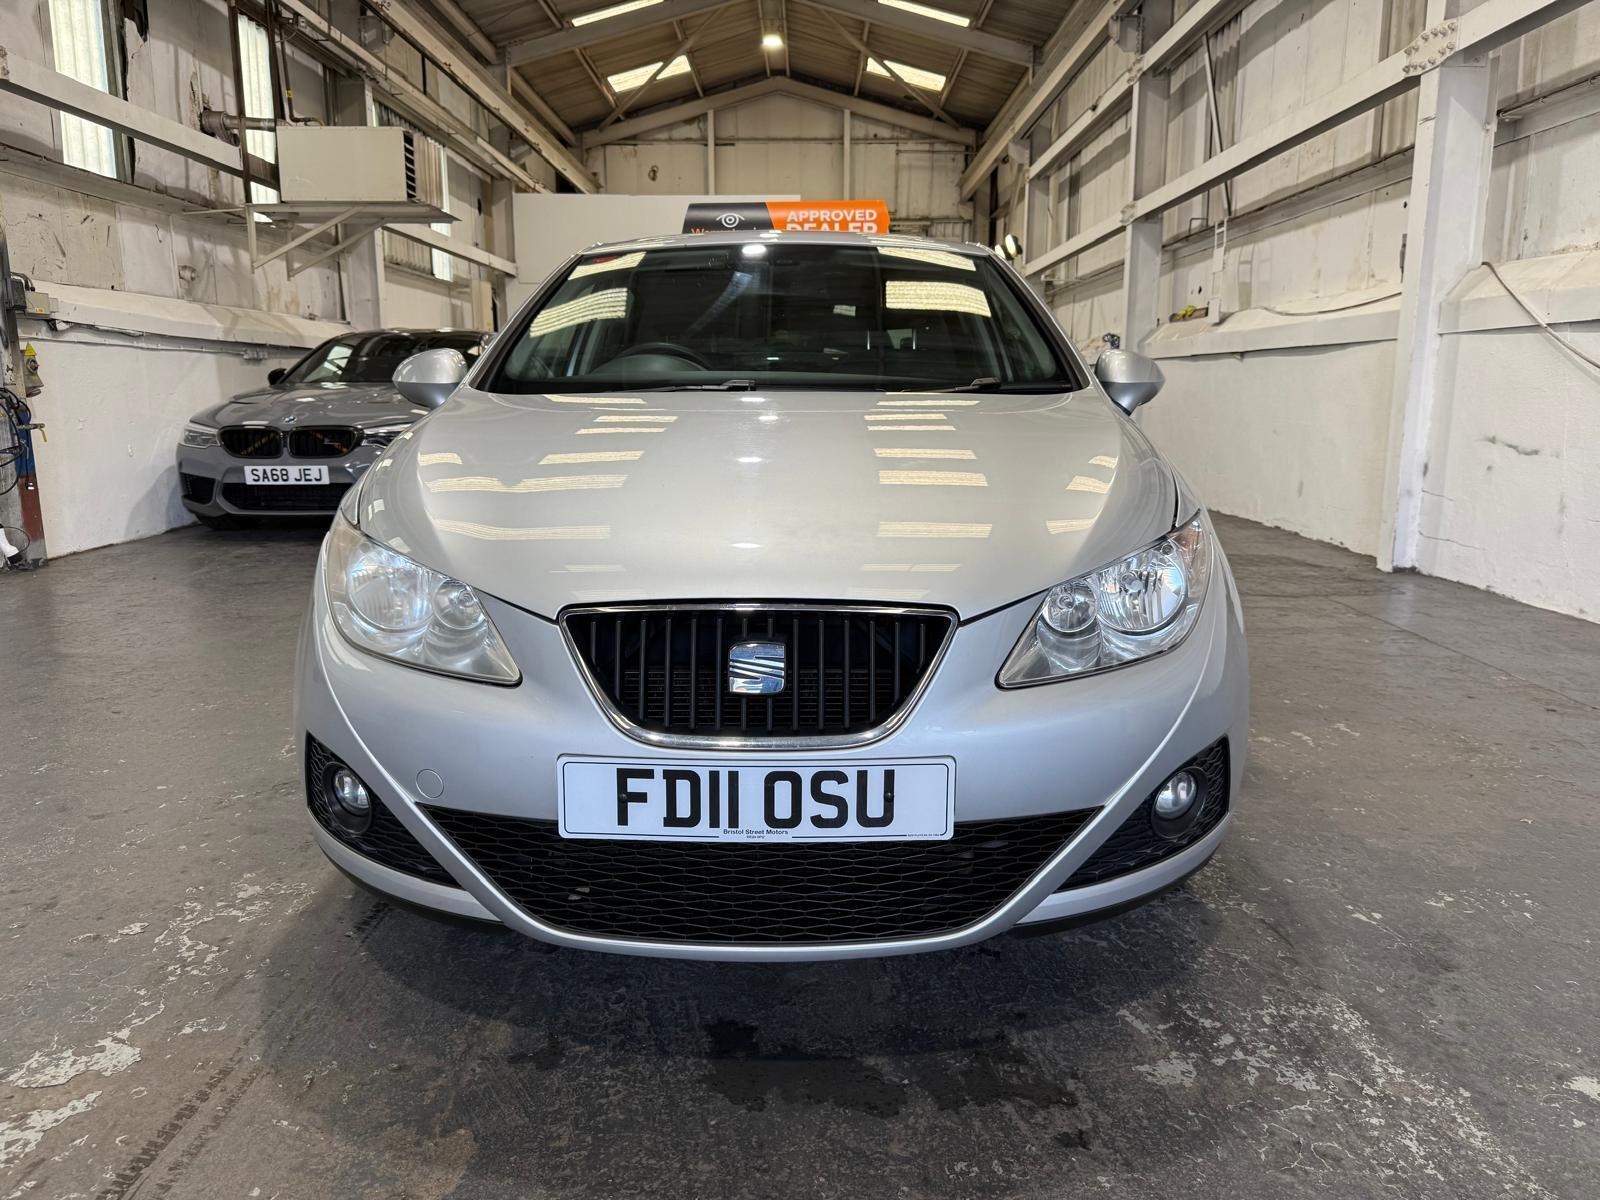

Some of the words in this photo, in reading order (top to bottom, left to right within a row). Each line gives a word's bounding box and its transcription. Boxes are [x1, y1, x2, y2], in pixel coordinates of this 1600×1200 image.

[786, 209, 877, 222] APPROVED
[251, 468, 289, 482] SA68
[294, 468, 322, 482] JEJ
[616, 768, 739, 828] FD11
[763, 769, 895, 829] OSU
